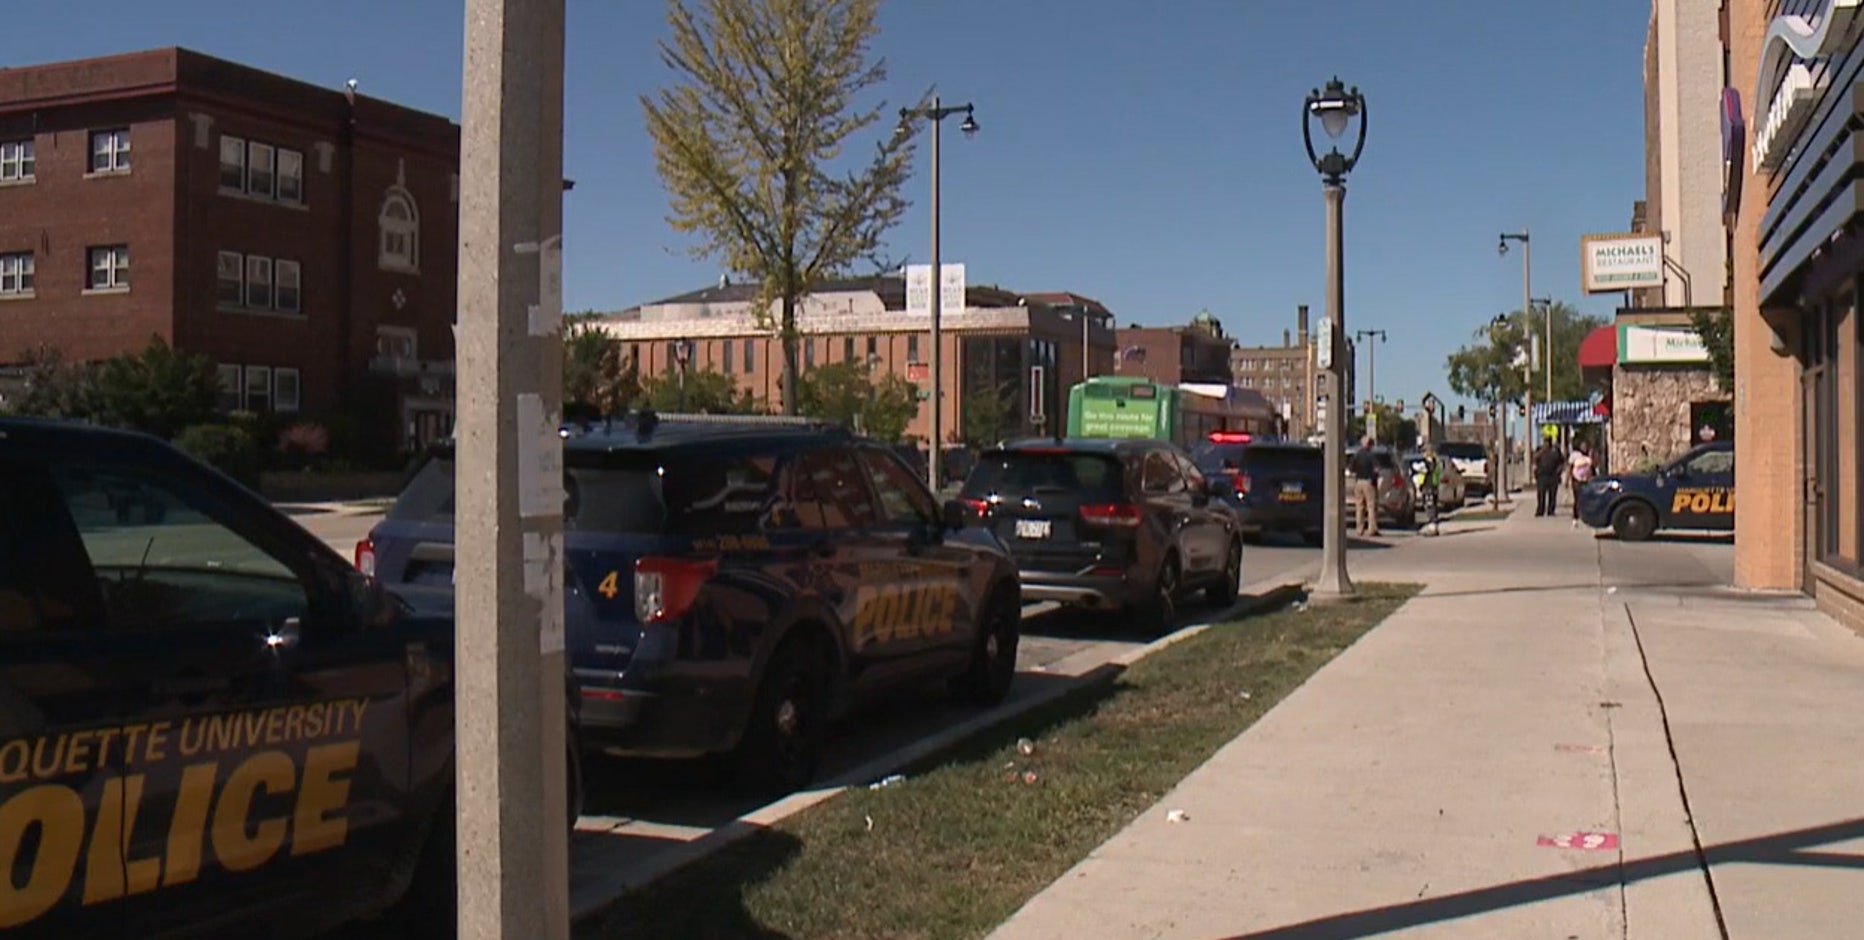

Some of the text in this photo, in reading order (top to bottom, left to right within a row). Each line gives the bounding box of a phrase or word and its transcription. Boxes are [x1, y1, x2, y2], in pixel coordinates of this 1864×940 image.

[1596, 255, 1654, 267] RESTAURANT
[598, 571, 619, 599] 4
[853, 583, 957, 648] POLICE
[179, 697, 371, 753] UNIVERSITY
[0, 741, 361, 930] OLICE
